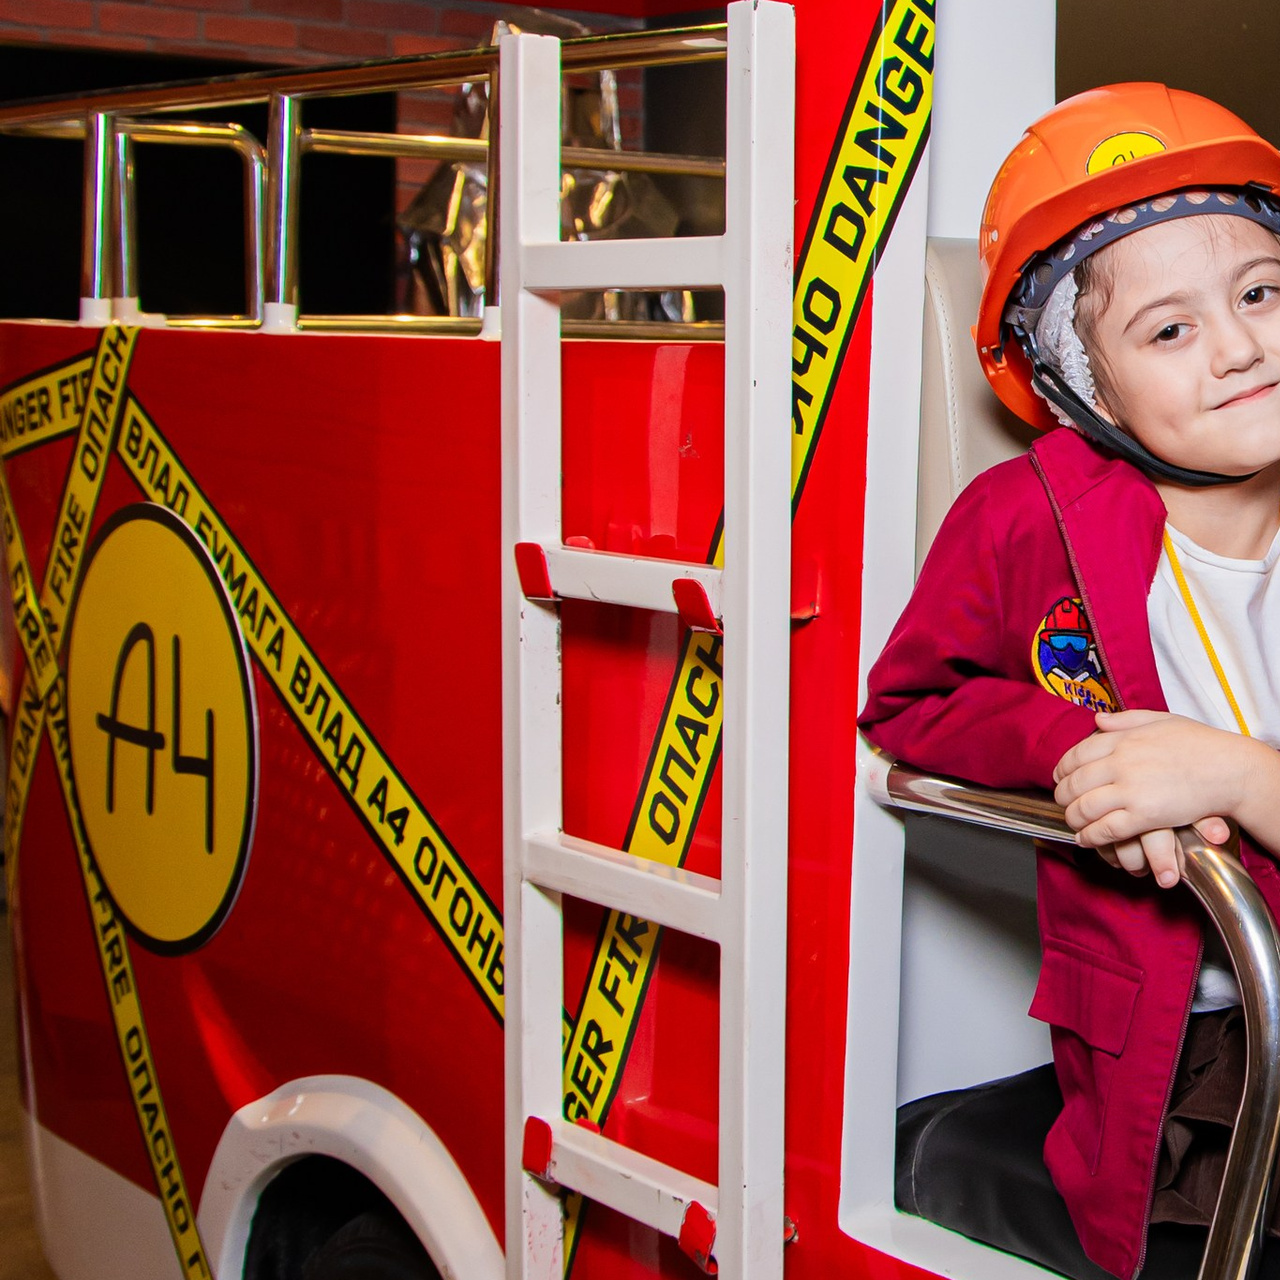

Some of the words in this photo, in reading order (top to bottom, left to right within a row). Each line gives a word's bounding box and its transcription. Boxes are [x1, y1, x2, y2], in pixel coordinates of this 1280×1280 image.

[0, 386, 52, 442] NGER
[50, 494, 86, 605] FIRE
[80, 326, 136, 482] ОПАСН
[124, 416, 190, 518] ВЛАД
[289, 654, 366, 796] ВЛАД
[413, 836, 505, 996] ОГОНЬ
[125, 1025, 189, 1236] ОПАСНО
